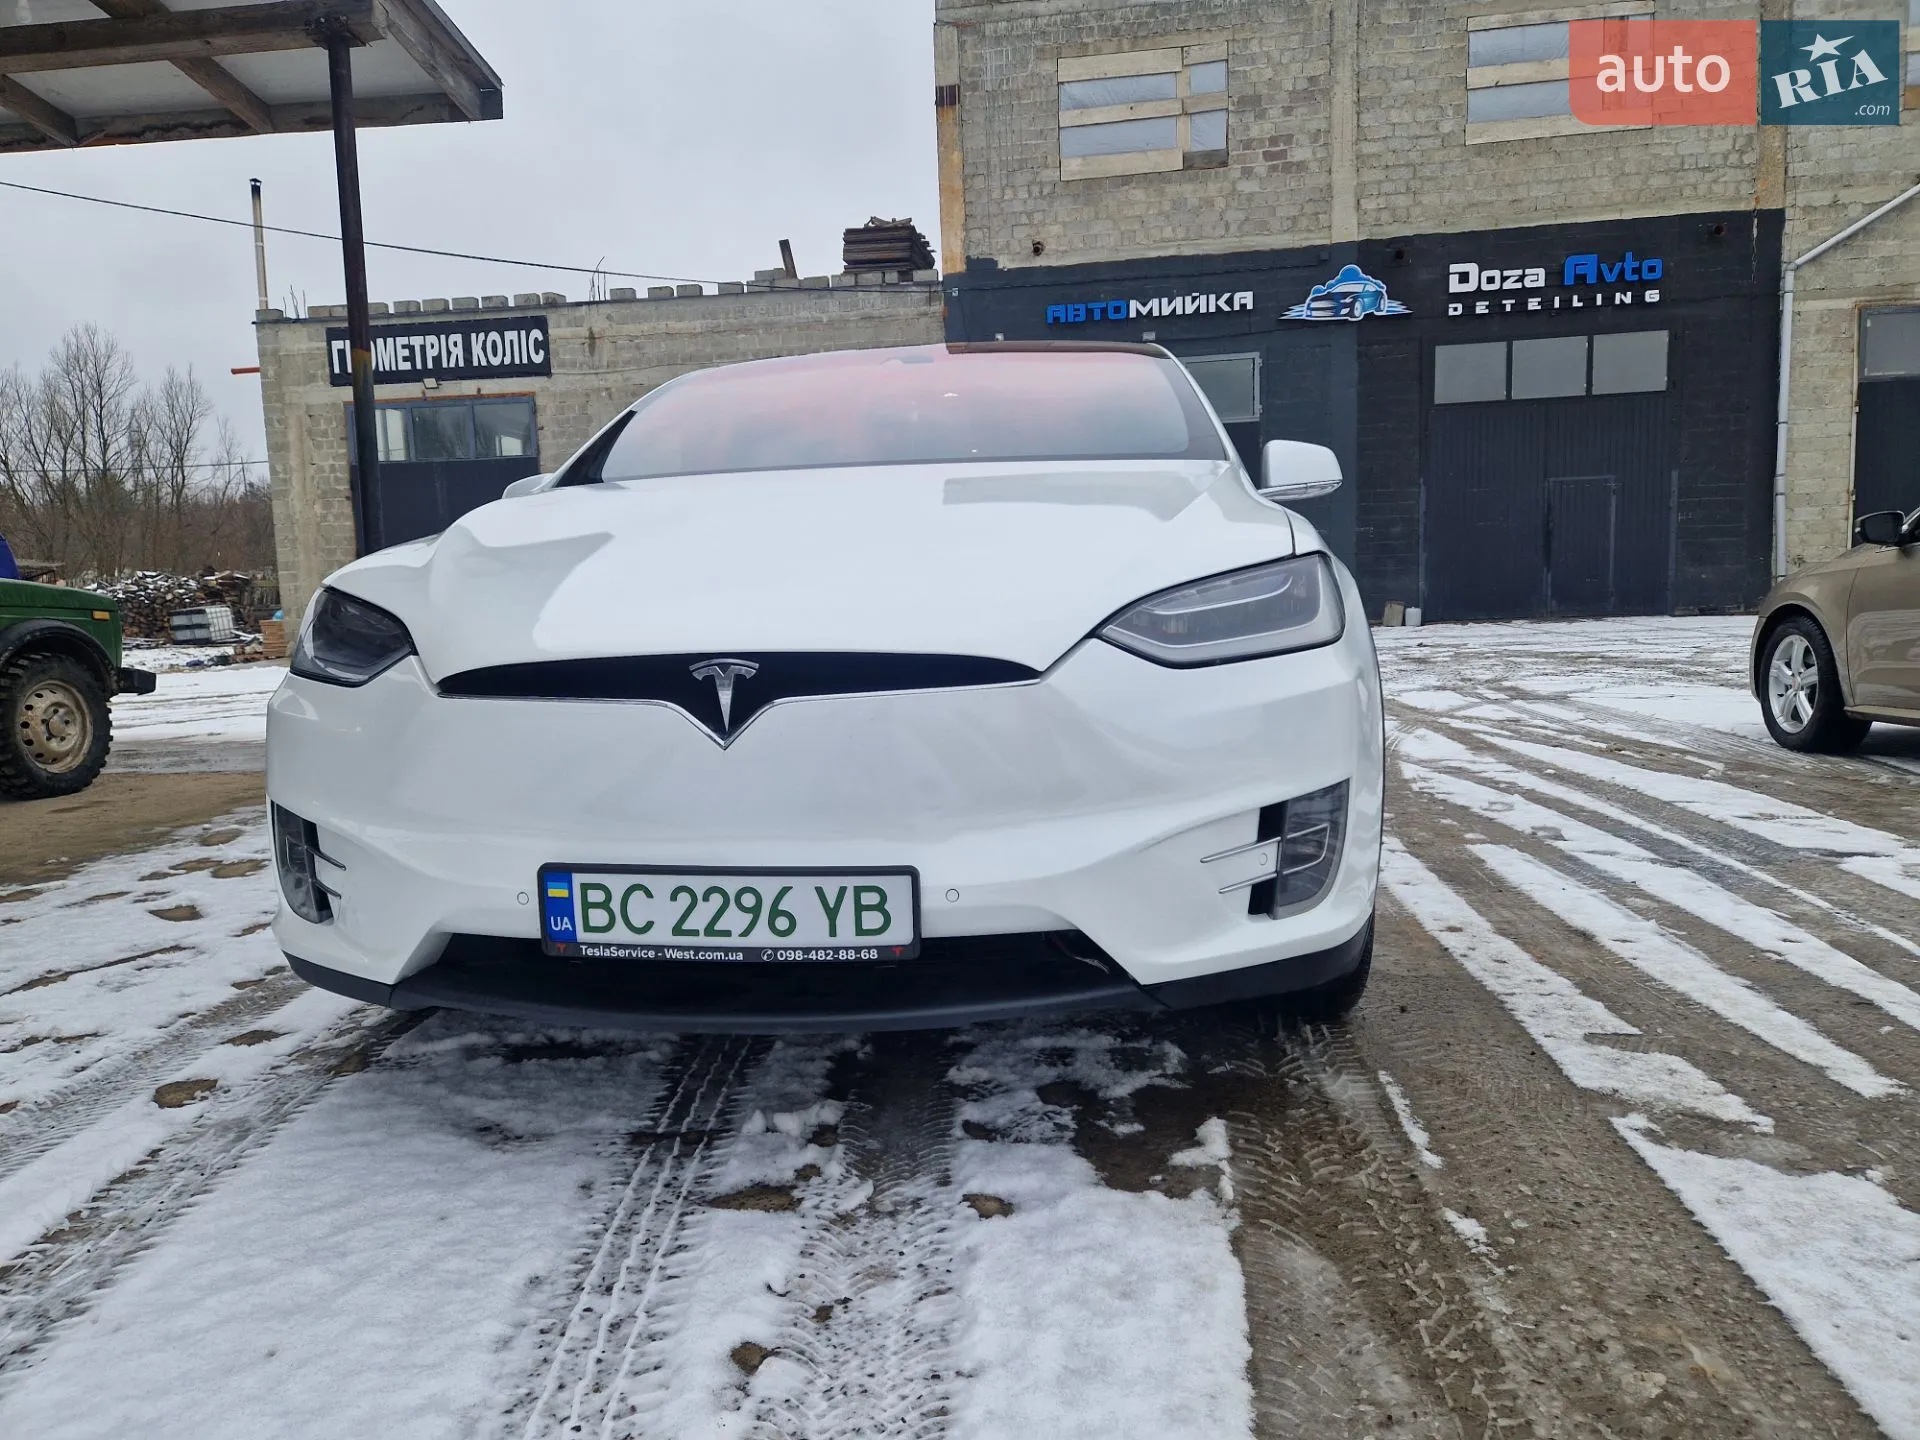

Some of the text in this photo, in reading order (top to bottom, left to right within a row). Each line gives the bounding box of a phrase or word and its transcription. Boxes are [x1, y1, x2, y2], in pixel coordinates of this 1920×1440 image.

[1046, 290, 1254, 324] АВТОМИЙКА
[1448, 289, 1661, 316] DETEILING
[331, 328, 545, 374] ГМЕТРІЯ КОЛІС
[550, 916, 573, 931] UA
[579, 882, 892, 938] BC 2296 YB
[579, 945, 656, 959] TeslaService
[664, 948, 744, 961] West.com.ua
[777, 949, 879, 961] 098-482-88-68
